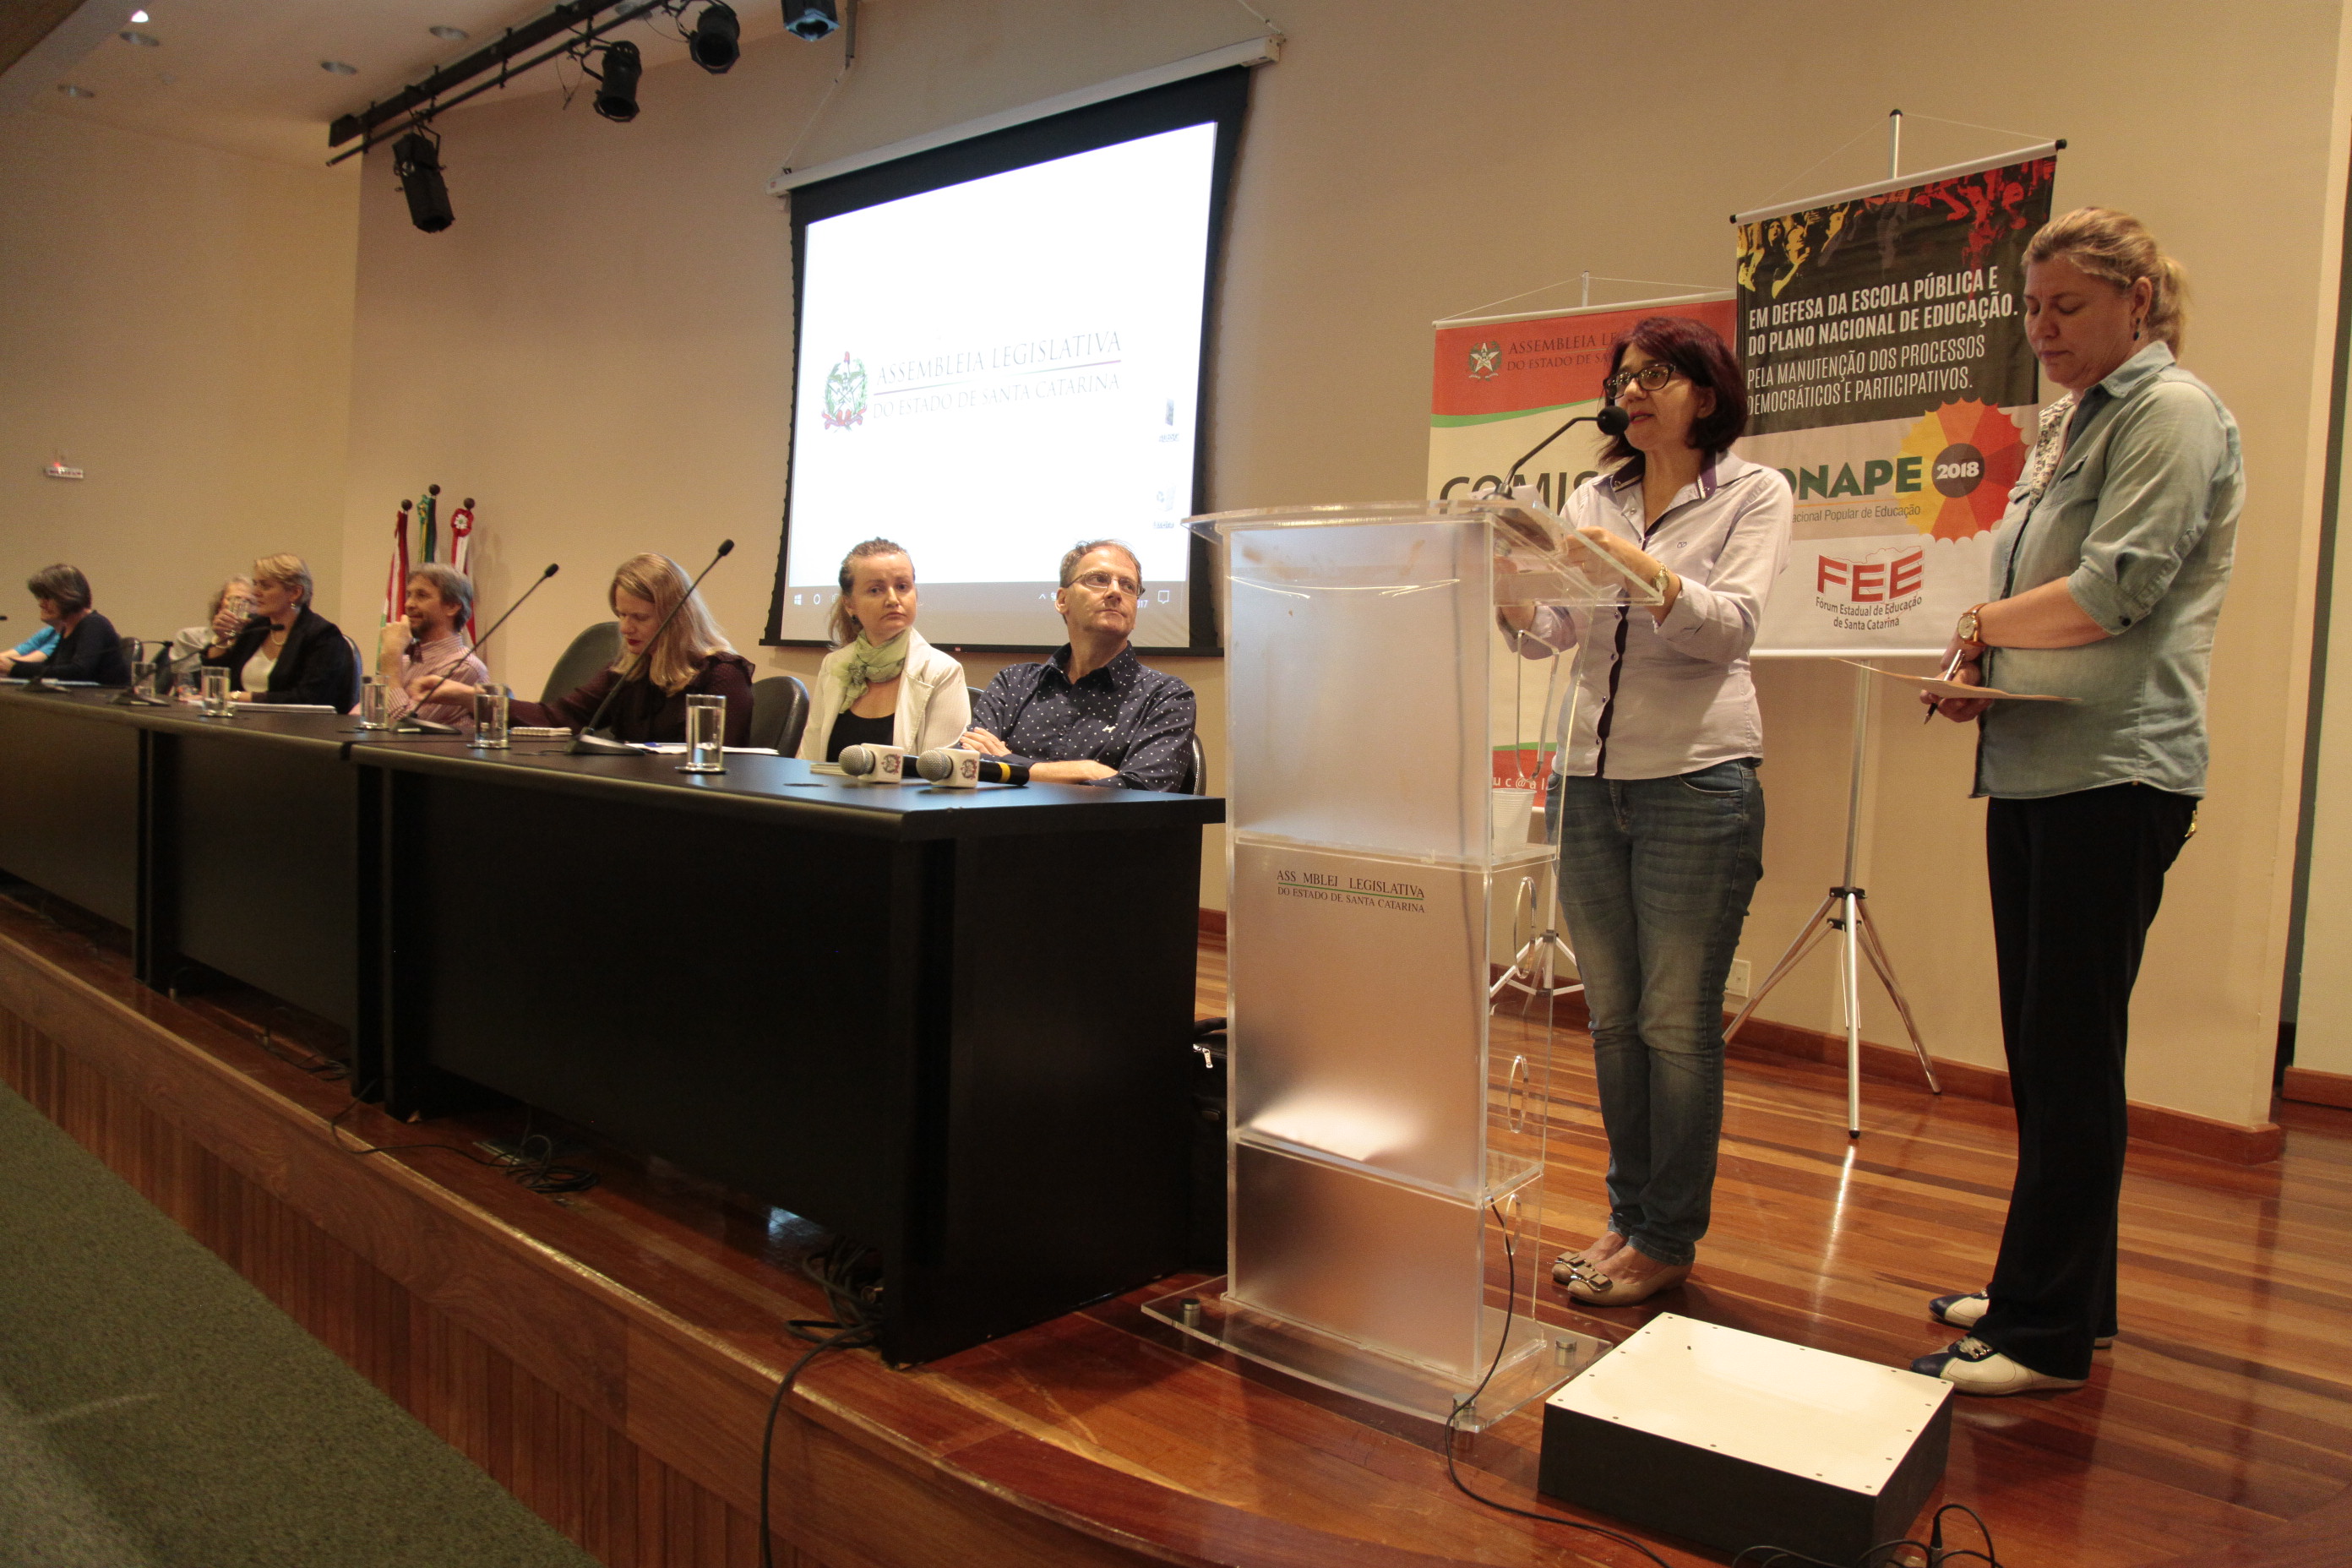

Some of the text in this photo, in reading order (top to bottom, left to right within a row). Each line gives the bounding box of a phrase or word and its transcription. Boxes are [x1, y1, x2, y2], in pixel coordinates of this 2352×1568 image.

[1749, 265, 1999, 330] EM DEFESA DA ESCOLA PÚBLICA E
[1748, 291, 2018, 357] DO PLANO NACIONAL DE EDUCAÇÃO.
[877, 330, 1121, 386] ASSEMBLEIA LEGISLATIVA
[1508, 335, 1596, 355] ASSEMBLEIA
[1507, 361, 1525, 371] DO
[1529, 356, 1572, 369] ESTADO
[1576, 354, 1592, 365] DE
[1747, 335, 1985, 390] PELA MANUTENÇÃO DOS PROCESSOS
[874, 373, 1120, 419] DO ESTADO DE SANTA CATARINA
[1747, 366, 1974, 416] DEMOCRÁTICOS E PARTICIPATIVOS.
[1936, 460, 1979, 480] 2018
[1825, 509, 1858, 523] Popular
[1861, 507, 1872, 518] de
[1875, 504, 1920, 520] Educação
[1817, 549, 1924, 604] FEE
[1816, 596, 1922, 617] Fórum Estadual de Educação
[1833, 617, 1900, 630] de Santa Catarina
[1277, 886, 1425, 913] DO ESTADO DE SANTA CATARINA
[1349, 877, 1425, 898] LEGISLATIVA
